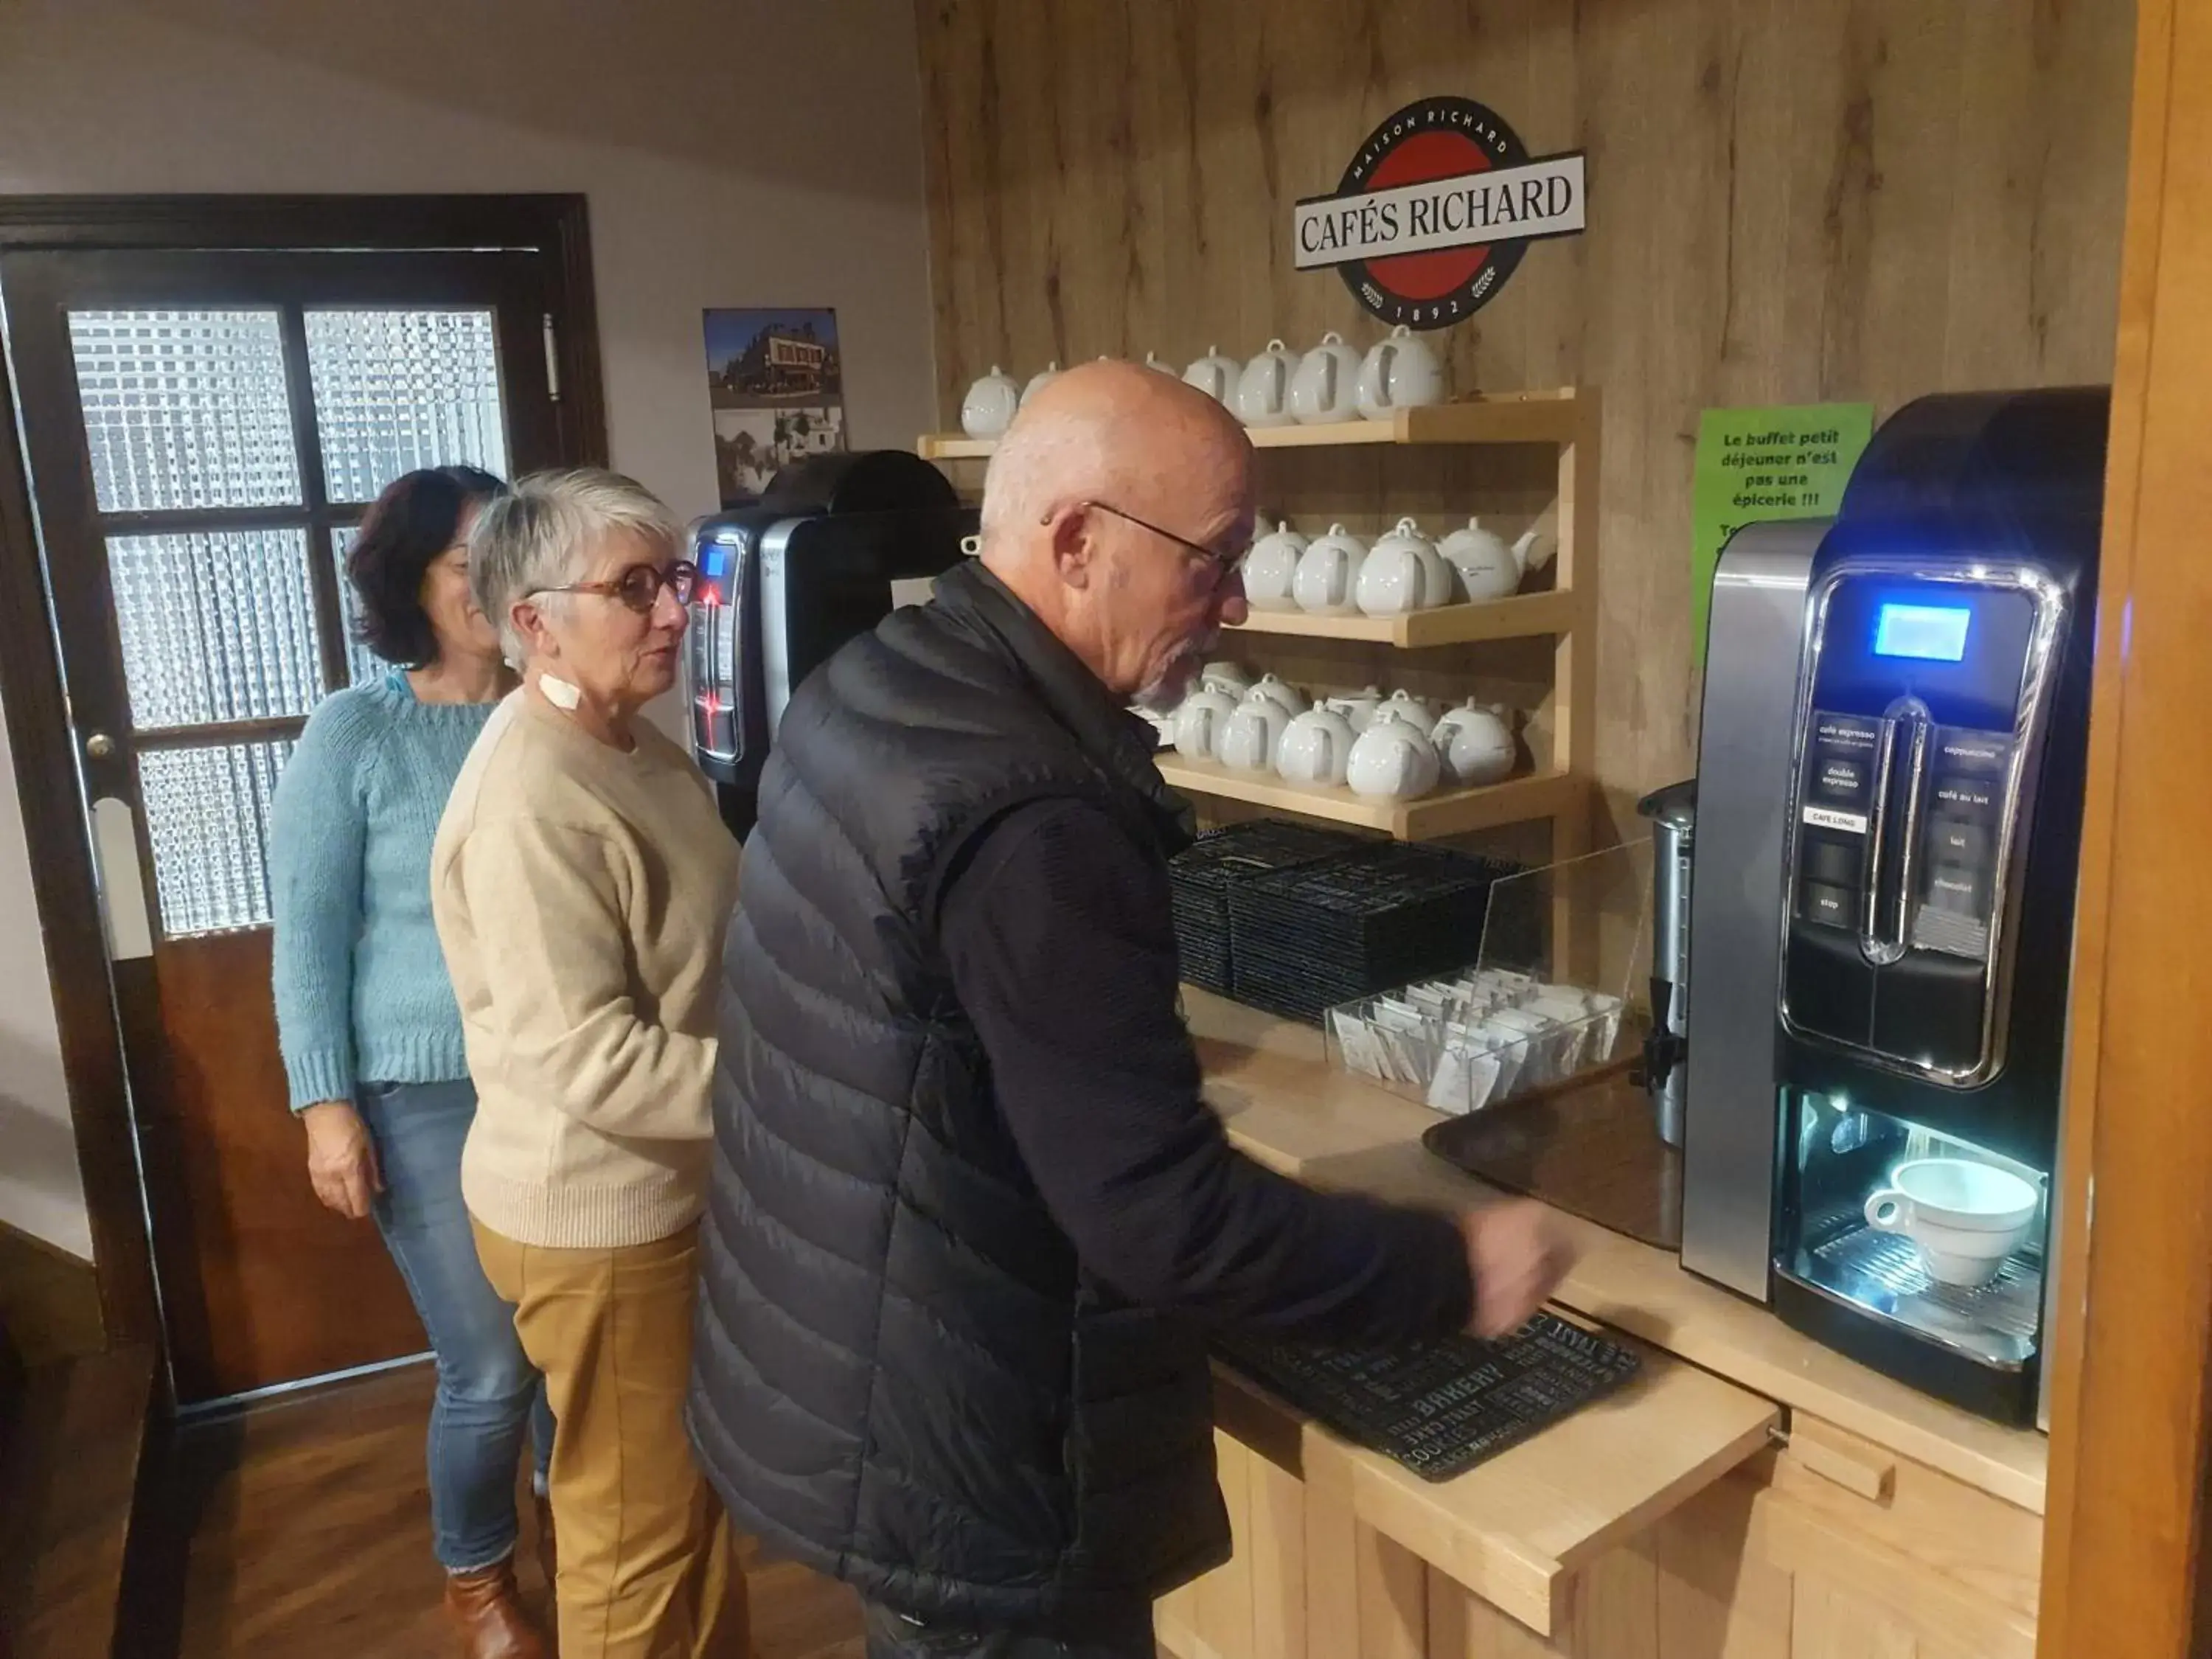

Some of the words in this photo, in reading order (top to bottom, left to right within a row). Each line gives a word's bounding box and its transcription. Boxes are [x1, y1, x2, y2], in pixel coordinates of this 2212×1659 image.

[1353, 116, 1416, 180] MAISON
[1427, 109, 1507, 153] RICHARD
[1301, 198, 1400, 253] CAFÉS
[1408, 175, 1573, 237] RICHARD
[1396, 300, 1458, 321] 1892
[1723, 434, 1742, 447] Le
[1745, 431, 1796, 447] buffet
[1799, 428, 1840, 447] petit
[1721, 451, 1792, 469] déjeuner
[1745, 474, 1774, 490] pas
[1778, 474, 1809, 486] une
[1733, 492, 1796, 509] épicerie
[1801, 493, 1820, 507] !!!
[1828, 767, 1855, 778] double
[1938, 790, 1958, 801] café
[1959, 793, 1971, 802] au
[1973, 794, 1989, 805] lait
[1820, 898, 1839, 910] stop
